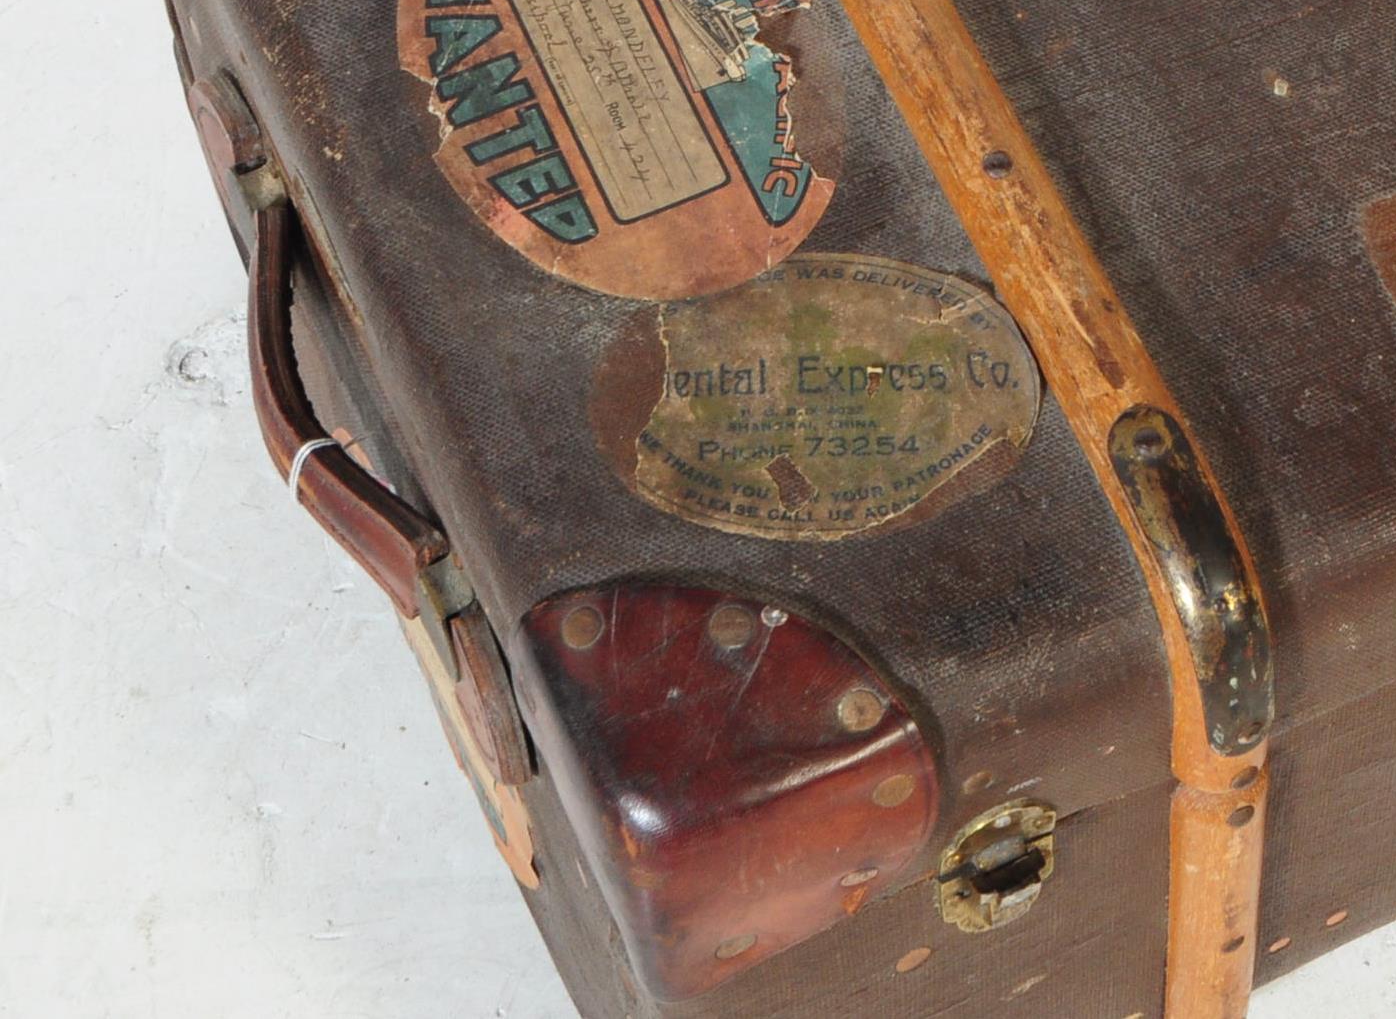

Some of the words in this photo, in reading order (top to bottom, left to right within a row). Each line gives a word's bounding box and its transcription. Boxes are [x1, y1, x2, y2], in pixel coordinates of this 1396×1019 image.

[605, 101, 629, 132] ROOM
[796, 268, 845, 280] WAS
[853, 270, 967, 311] DELIVERED
[797, 355, 947, 397] Expess
[967, 349, 1021, 389] Co.
[828, 419, 878, 430] CHINA
[732, 482, 770, 499] YOU
[831, 485, 886, 502] YOUR
[891, 423, 993, 492] PATRONAGE
[804, 435, 920, 457] 73254
[683, 488, 759, 518] PLEASE
[828, 509, 854, 522] US
